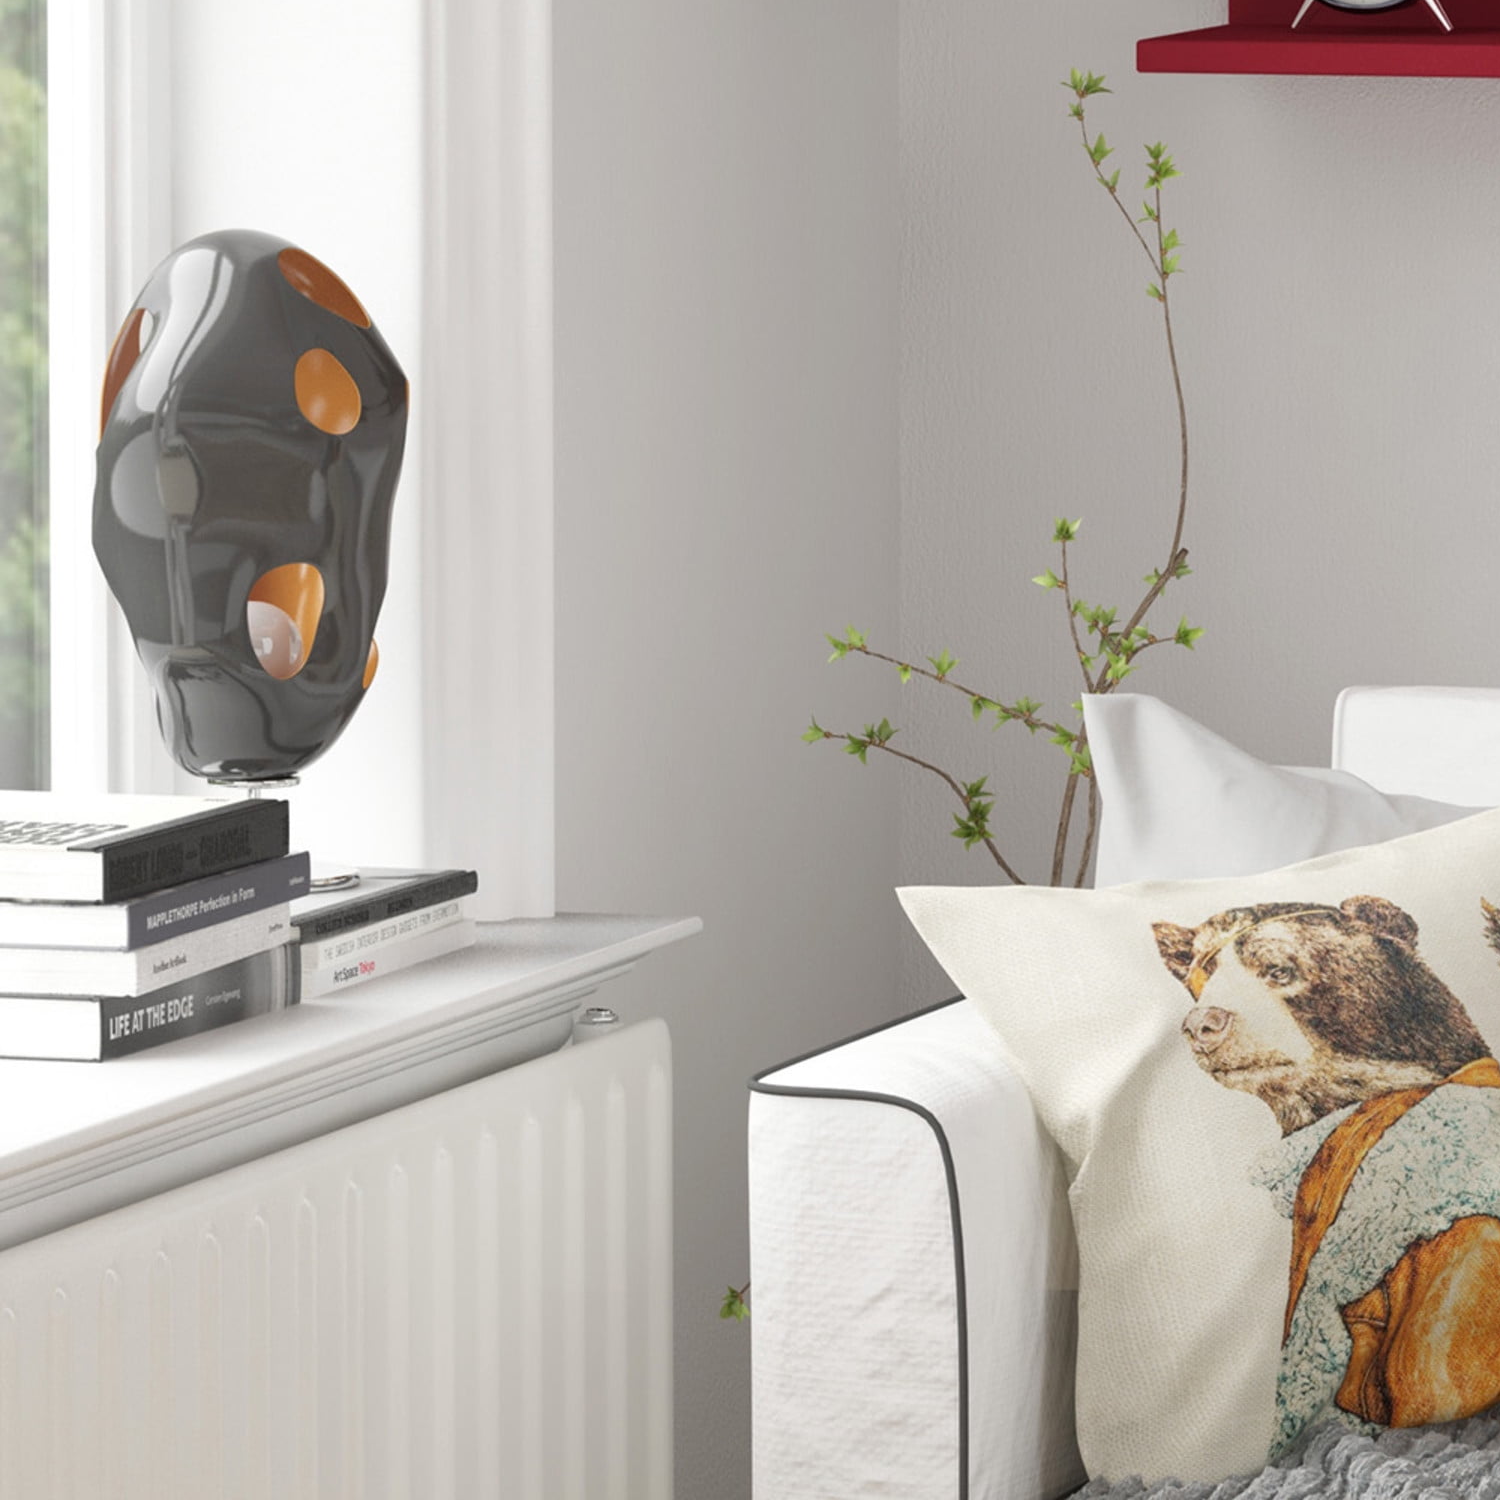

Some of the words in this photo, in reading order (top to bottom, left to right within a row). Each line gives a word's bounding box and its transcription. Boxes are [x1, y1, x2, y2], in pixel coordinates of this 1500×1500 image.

[109, 1013, 130, 1040] LIFE
[132, 1009, 145, 1034] AT
[146, 1003, 166, 1029] THE
[167, 995, 194, 1023] EDGE
